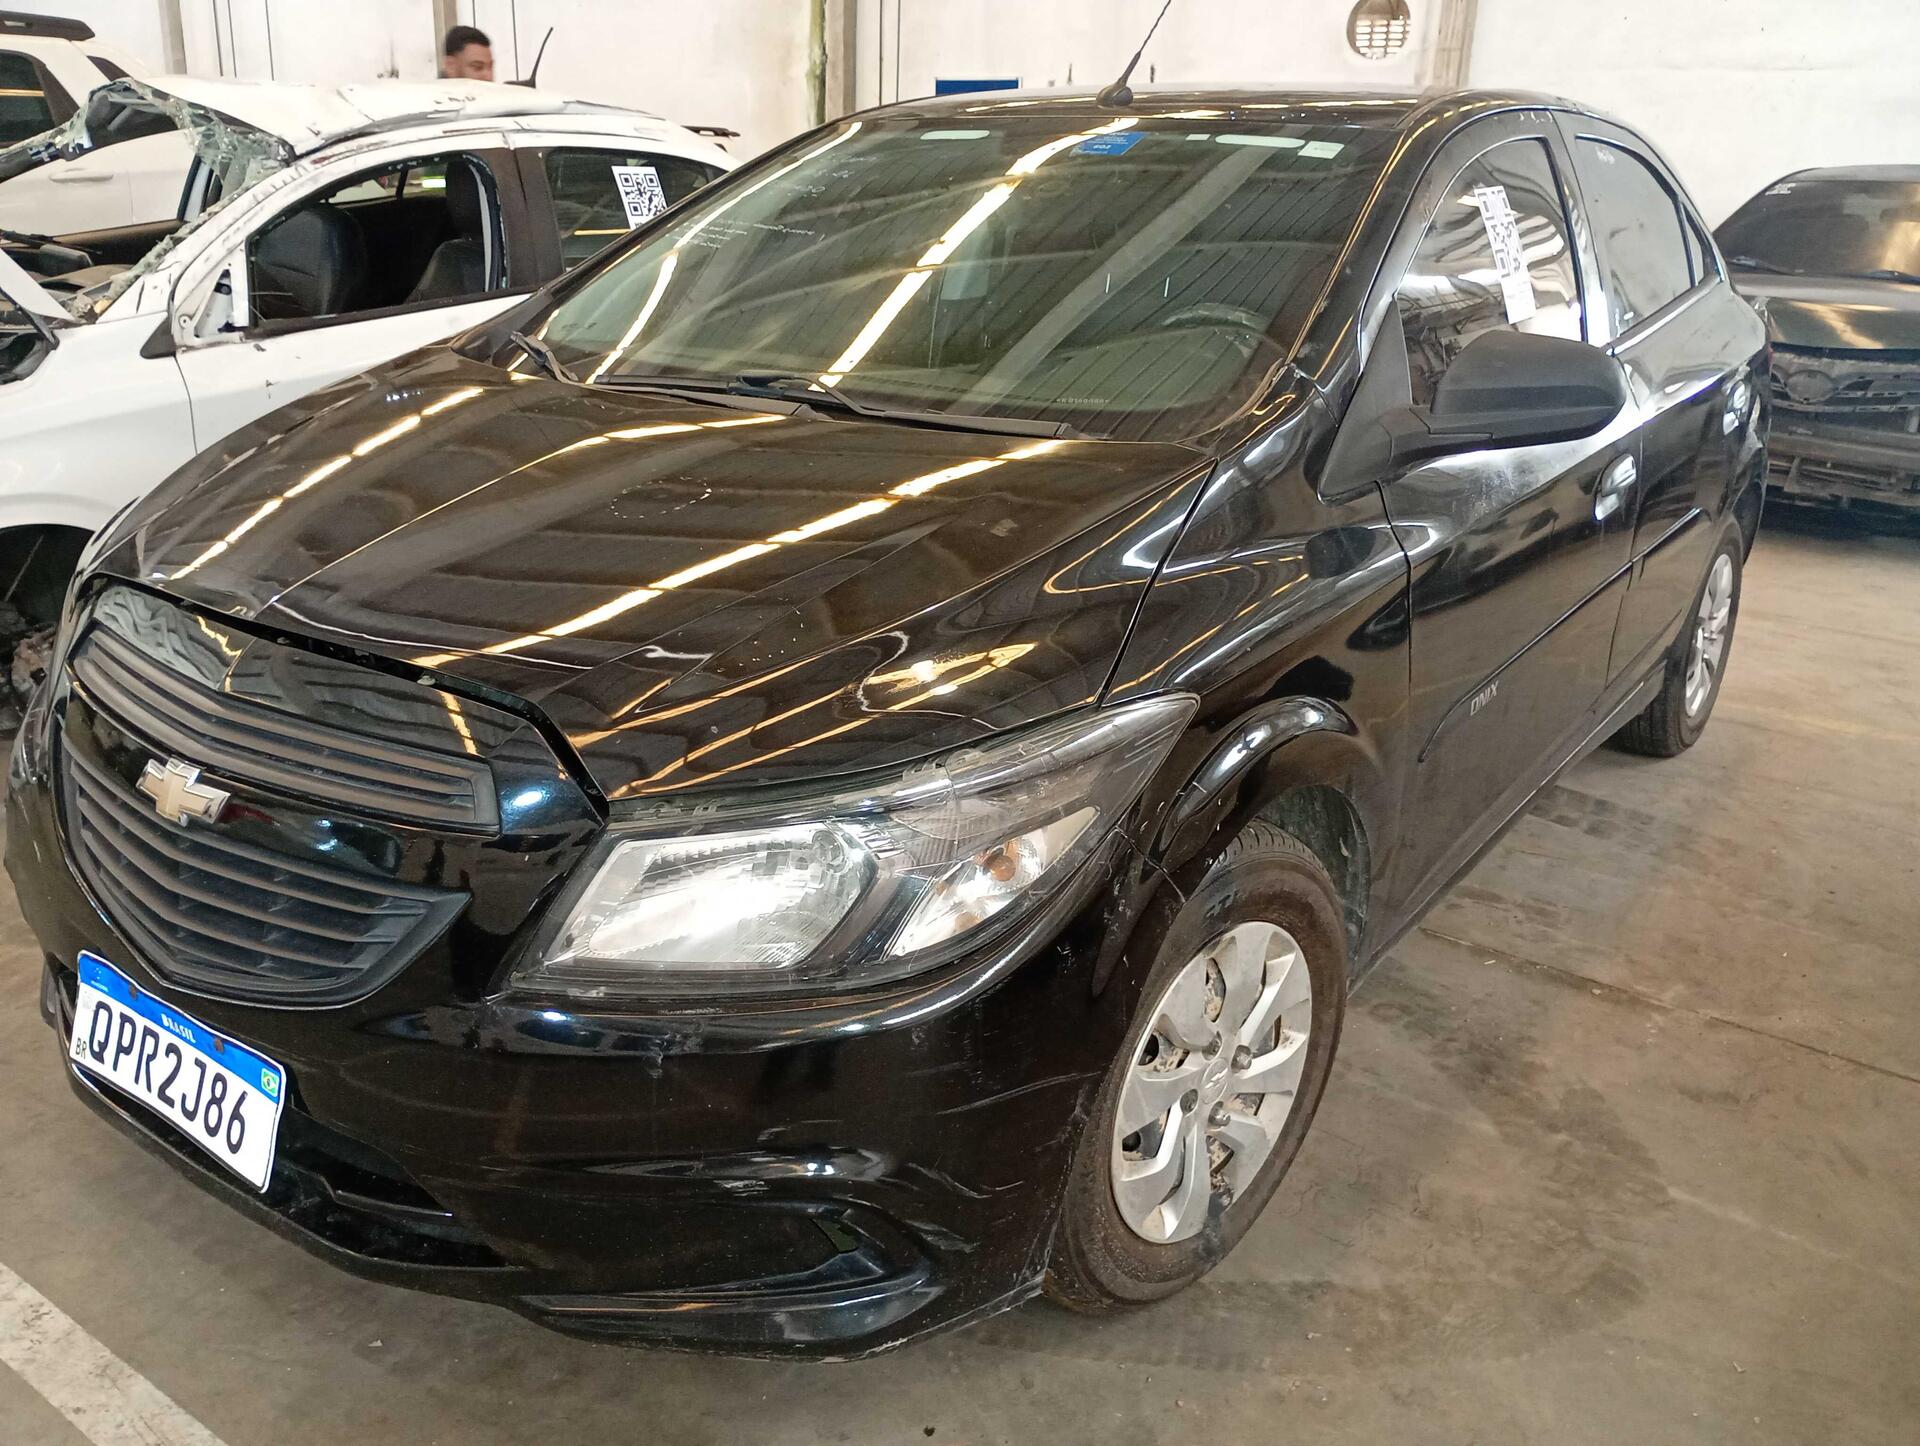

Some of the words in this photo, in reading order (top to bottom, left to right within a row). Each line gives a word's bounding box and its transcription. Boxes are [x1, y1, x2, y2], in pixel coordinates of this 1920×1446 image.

[1471, 680, 1498, 716] ONIX
[161, 1013, 196, 1043] BRASIL
[75, 1037, 87, 1059] BR
[89, 1001, 248, 1155] QPR2J86
